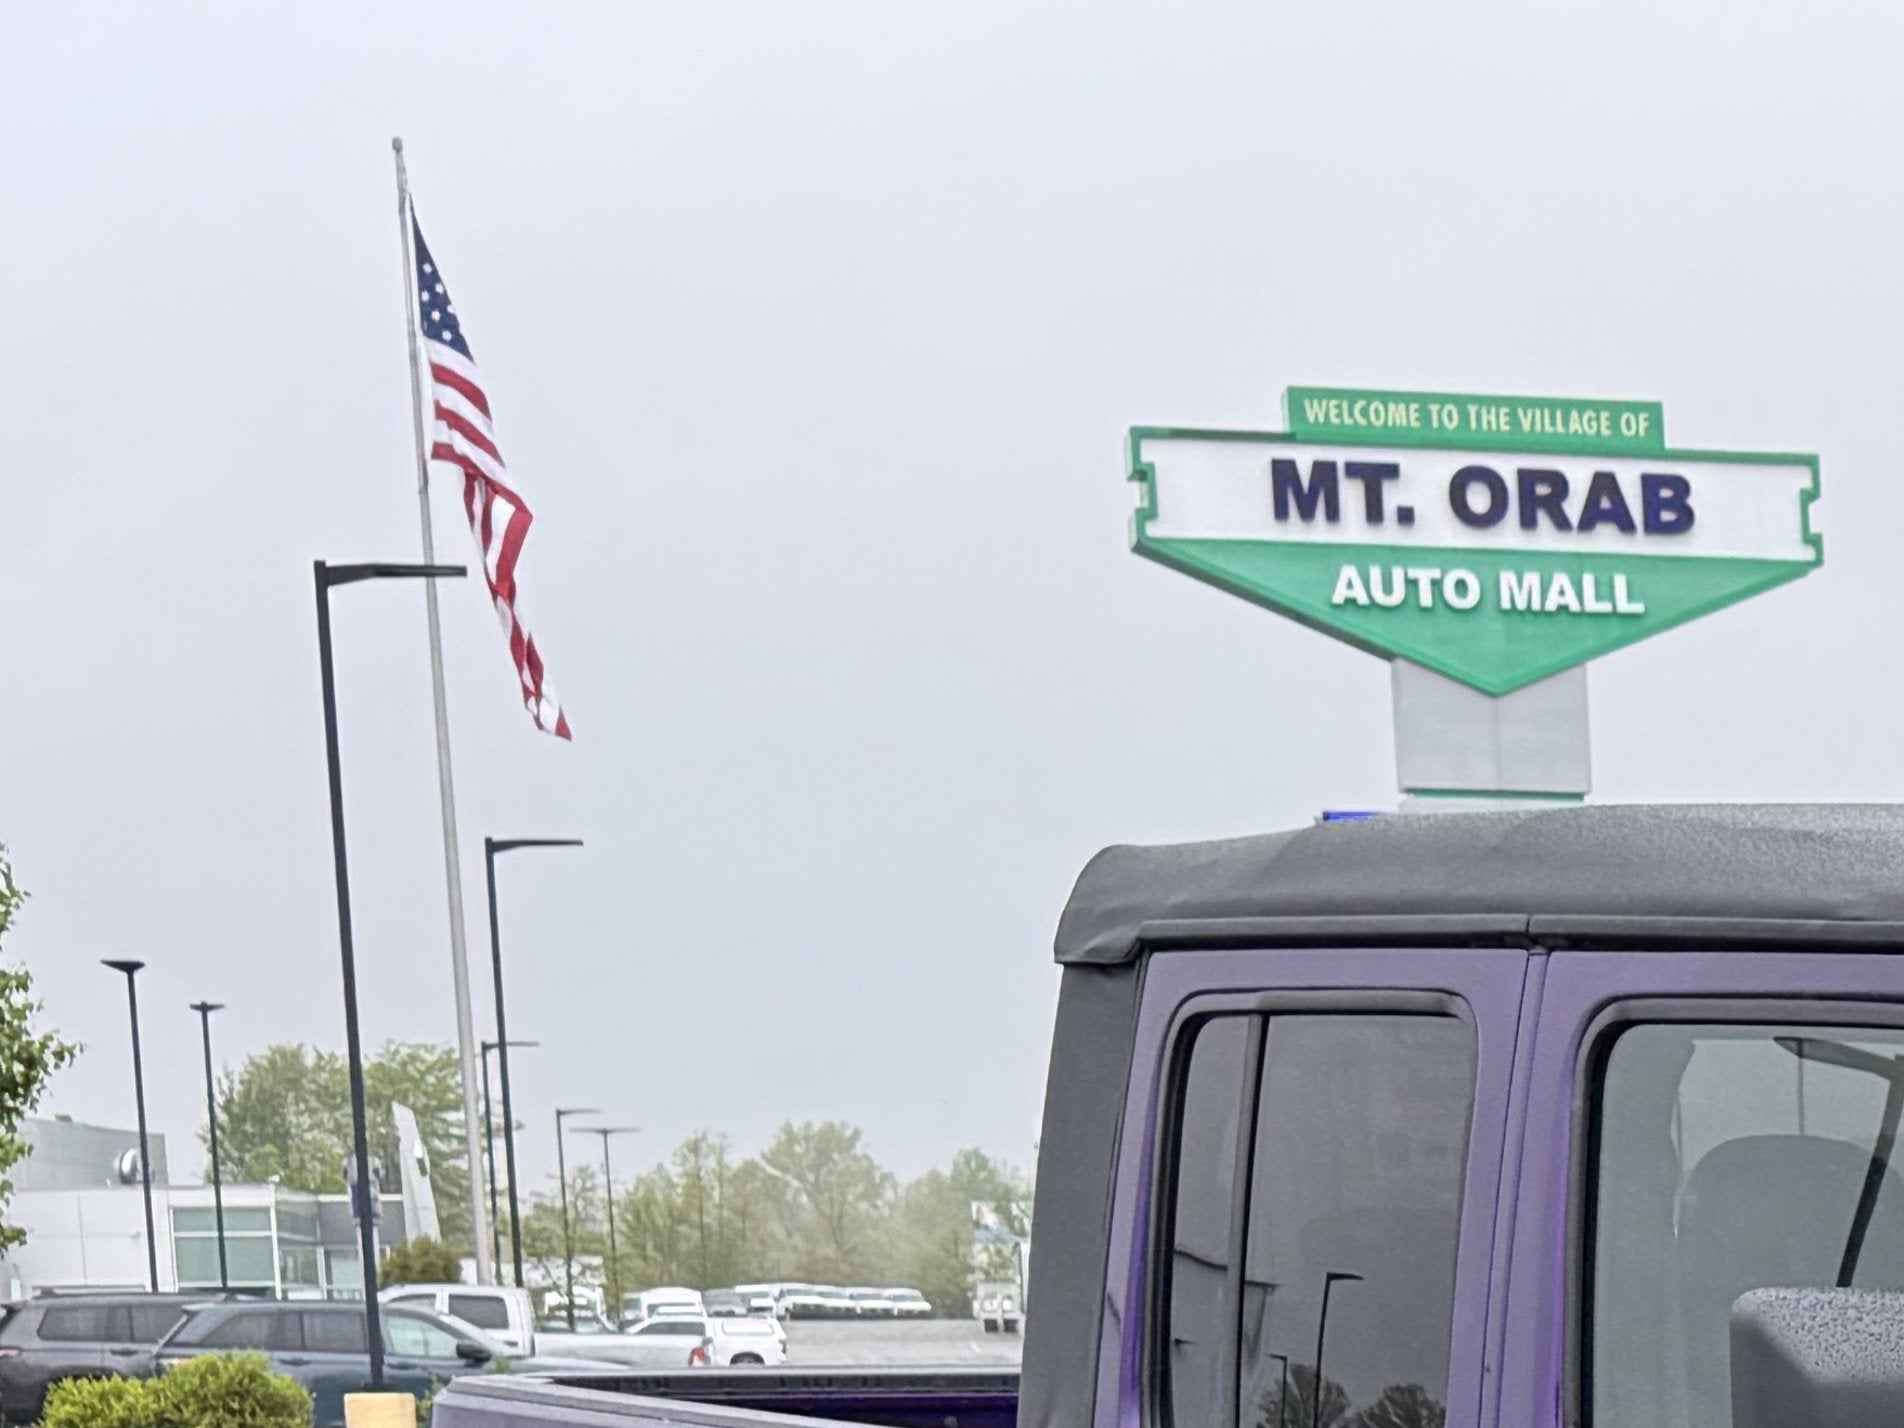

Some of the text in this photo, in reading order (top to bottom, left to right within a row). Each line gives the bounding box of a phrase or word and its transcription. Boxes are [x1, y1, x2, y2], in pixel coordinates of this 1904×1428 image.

[1304, 398, 1650, 438] WELCOME TO THE VILLAGE OF
[1271, 457, 1696, 535] MT. ORAB
[1331, 565, 1646, 614] AUTO MALL
